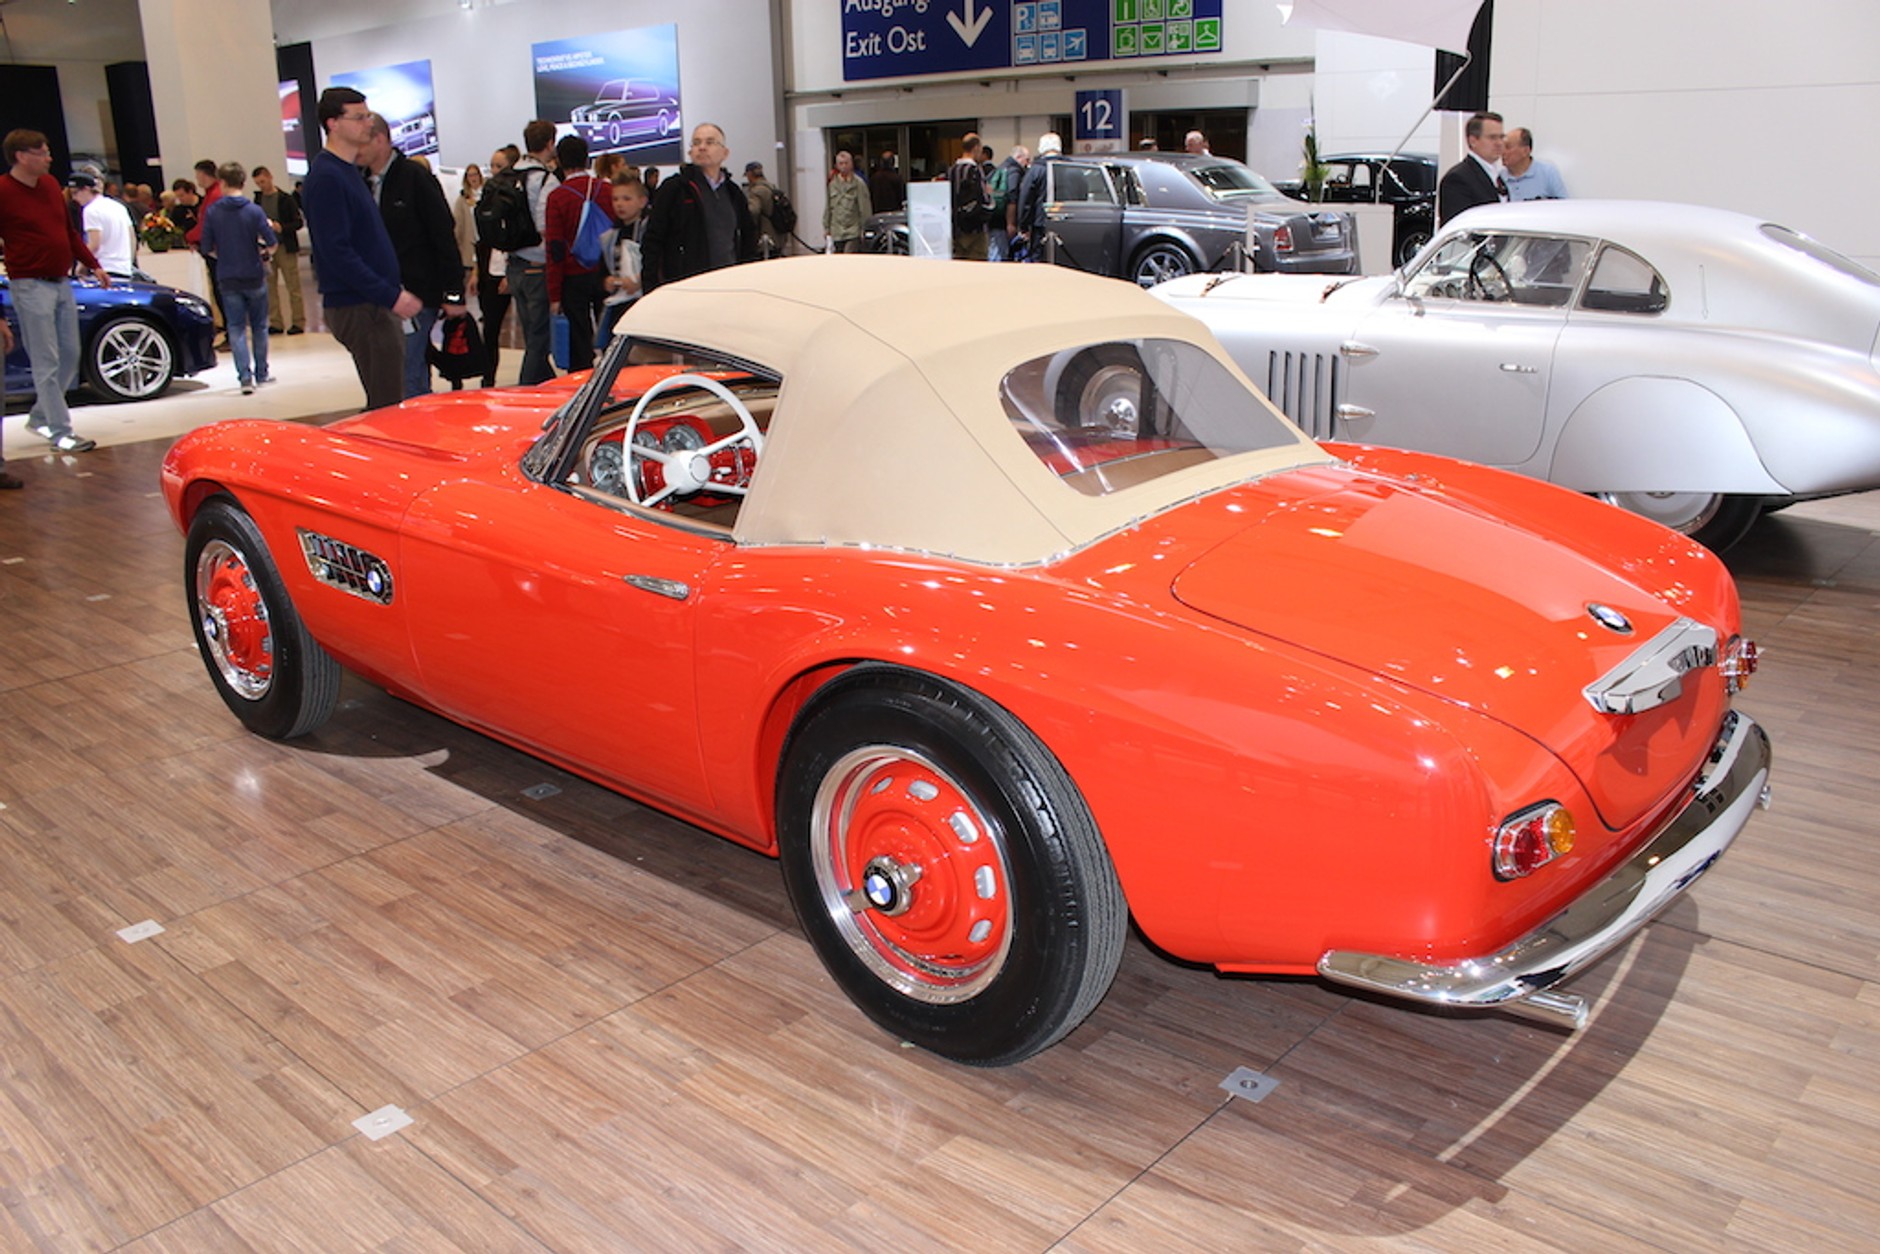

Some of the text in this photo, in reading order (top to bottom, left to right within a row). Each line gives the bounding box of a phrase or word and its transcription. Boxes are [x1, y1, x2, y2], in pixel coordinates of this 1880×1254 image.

[845, 0, 930, 17] Ausgg
[846, 26, 926, 57] Exit Ost
[1081, 99, 1113, 130] 12
